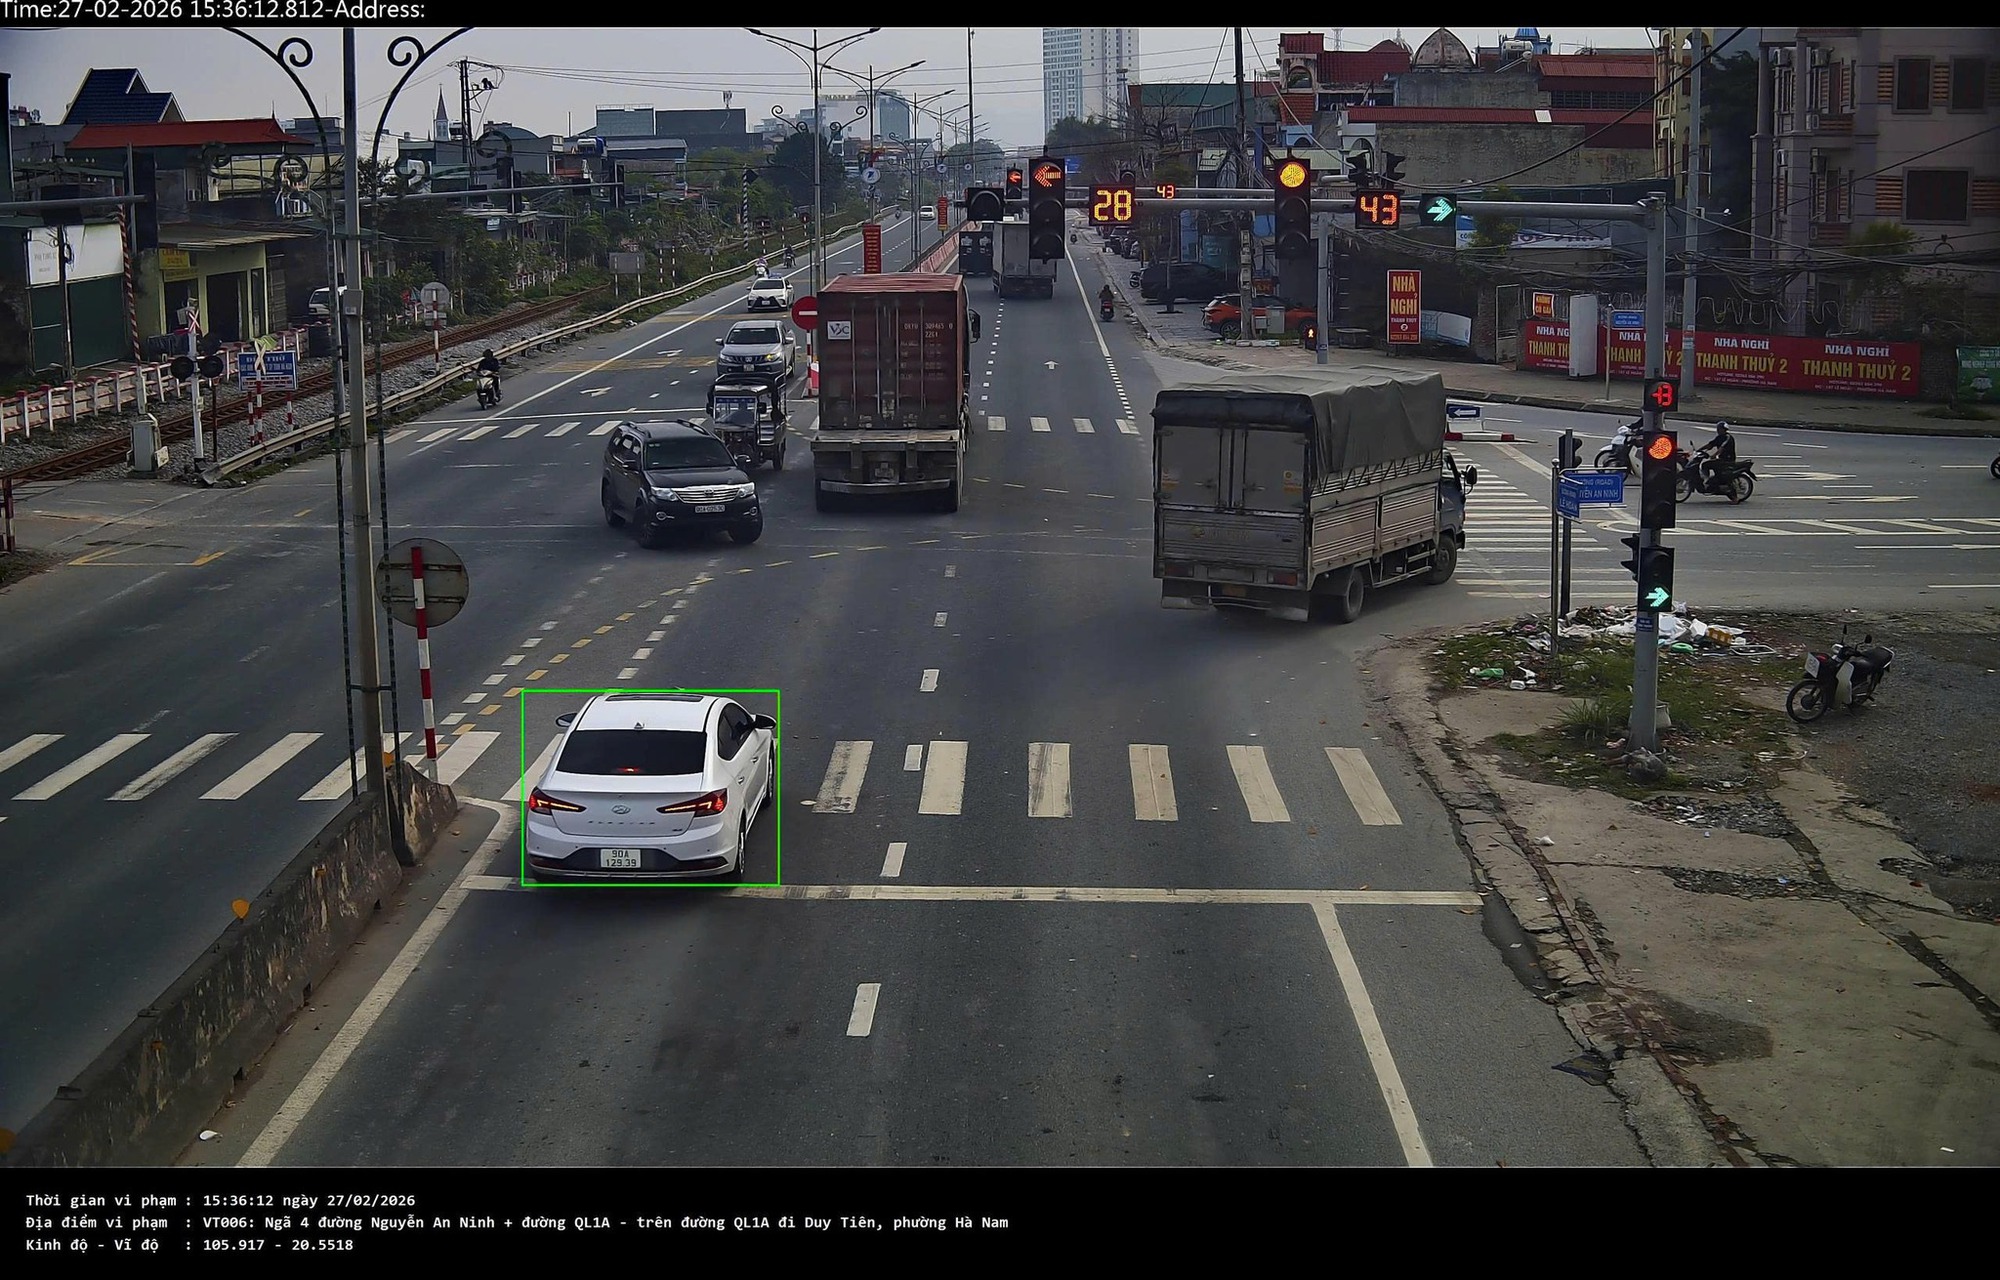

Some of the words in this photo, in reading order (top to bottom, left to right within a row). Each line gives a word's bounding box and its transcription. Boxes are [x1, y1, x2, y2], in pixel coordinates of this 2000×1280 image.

[1156, 185, 1174, 199] 43
[1094, 189, 1132, 221] 28
[1361, 194, 1398, 225] 43
[1392, 273, 1416, 292] NHÀ
[1391, 293, 1418, 315] NGHỈ
[1536, 325, 1555, 336] NHÀ
[1556, 327, 1570, 337] NG
[1619, 330, 1641, 341] NHÀ
[1529, 340, 1556, 356] THANH
[1558, 343, 1571, 357] TH
[1714, 336, 1738, 348] NHÀ
[1741, 338, 1770, 350] NGHỈ
[1824, 343, 1853, 355] NHÀ
[1856, 345, 1890, 357] NGHỈ
[1696, 352, 1738, 370] THANH
[1742, 352, 1776, 373] THUỶ
[1779, 359, 1788, 374] 2
[1802, 359, 1853, 378] THANH
[1857, 359, 1897, 380] THUỶ
[1901, 365, 1912, 381] 2
[1593, 489, 1603, 498] AN
[1603, 489, 1619, 498] NINH
[612, 849, 629, 858] 90A
[606, 859, 637, 867] 129.39
